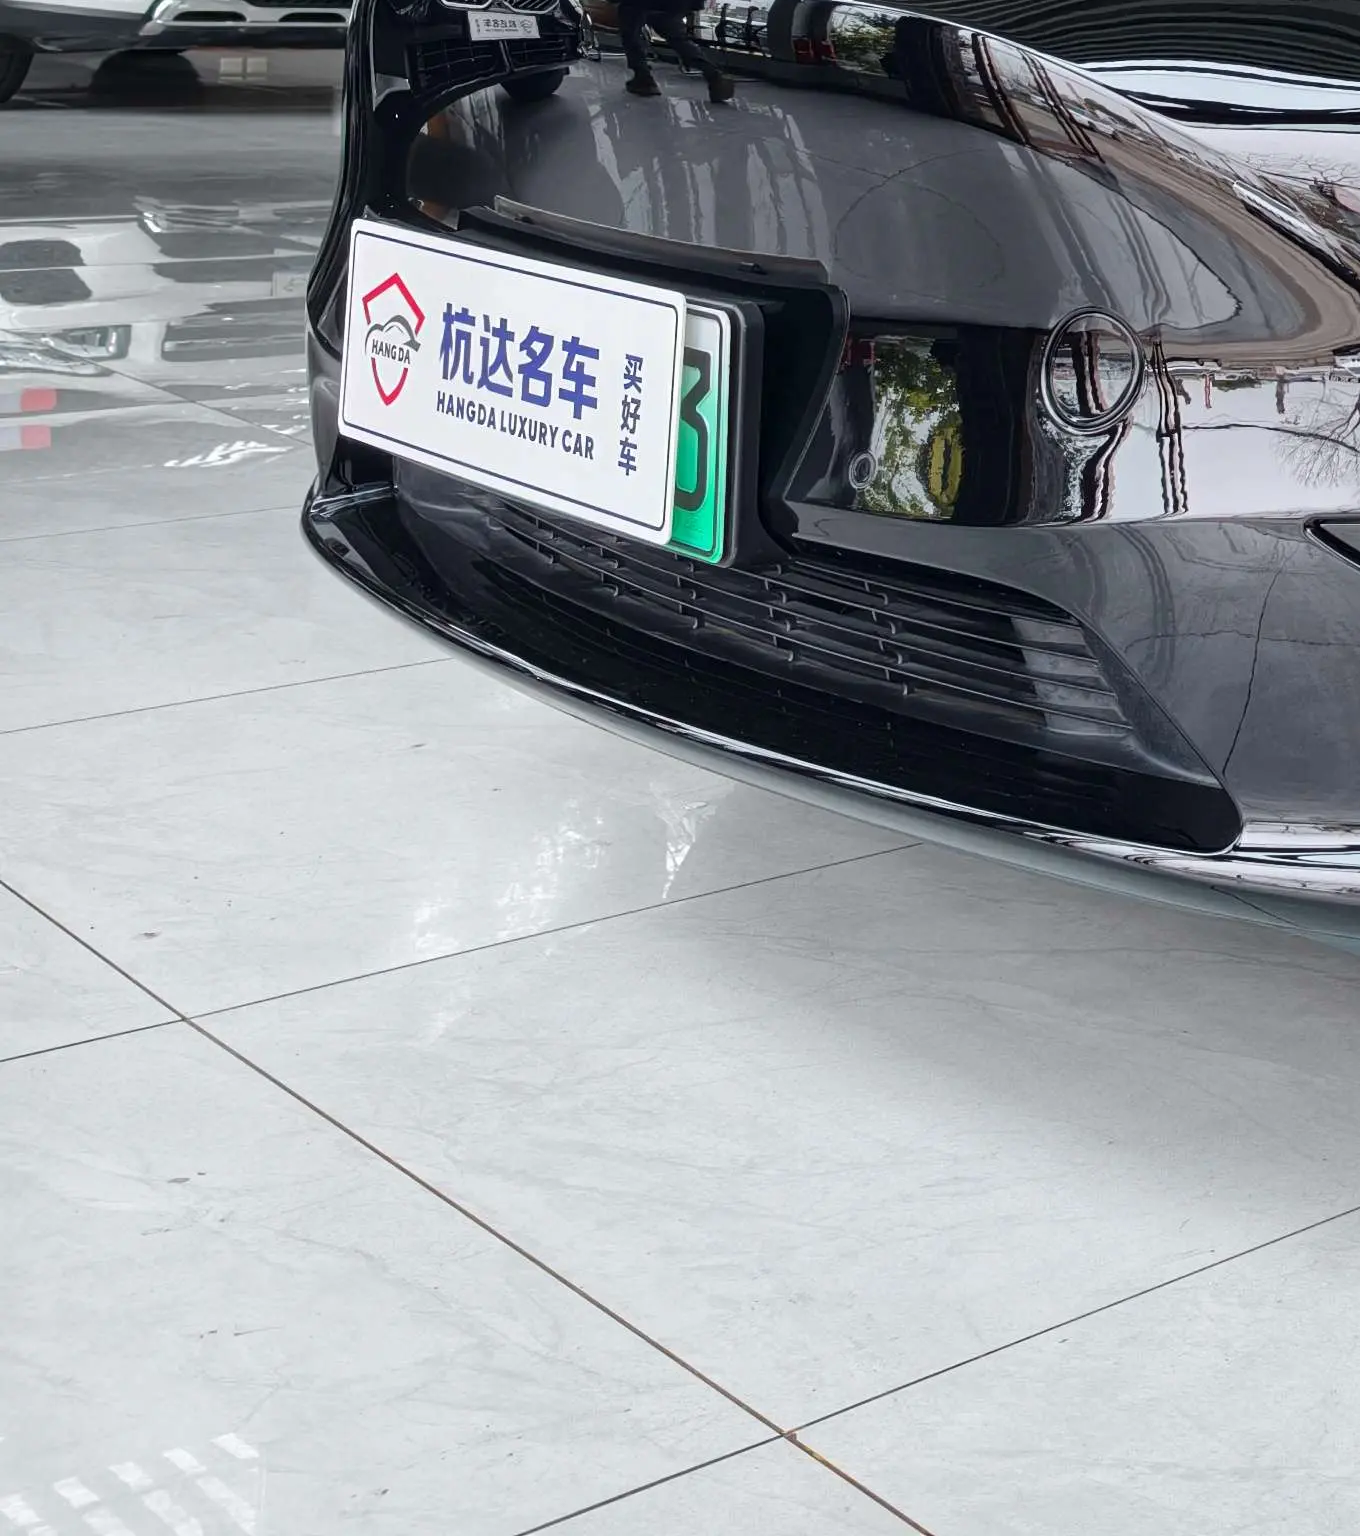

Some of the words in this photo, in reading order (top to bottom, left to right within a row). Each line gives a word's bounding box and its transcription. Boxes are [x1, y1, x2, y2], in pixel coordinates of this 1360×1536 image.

[371, 338, 397, 359] HANG
[398, 347, 411, 364] DA
[439, 302, 600, 421] 杭达名车
[436, 390, 497, 430] HANGDA
[500, 410, 559, 448] LUXURY
[561, 429, 595, 460] CAR
[617, 353, 644, 477] 买好车
